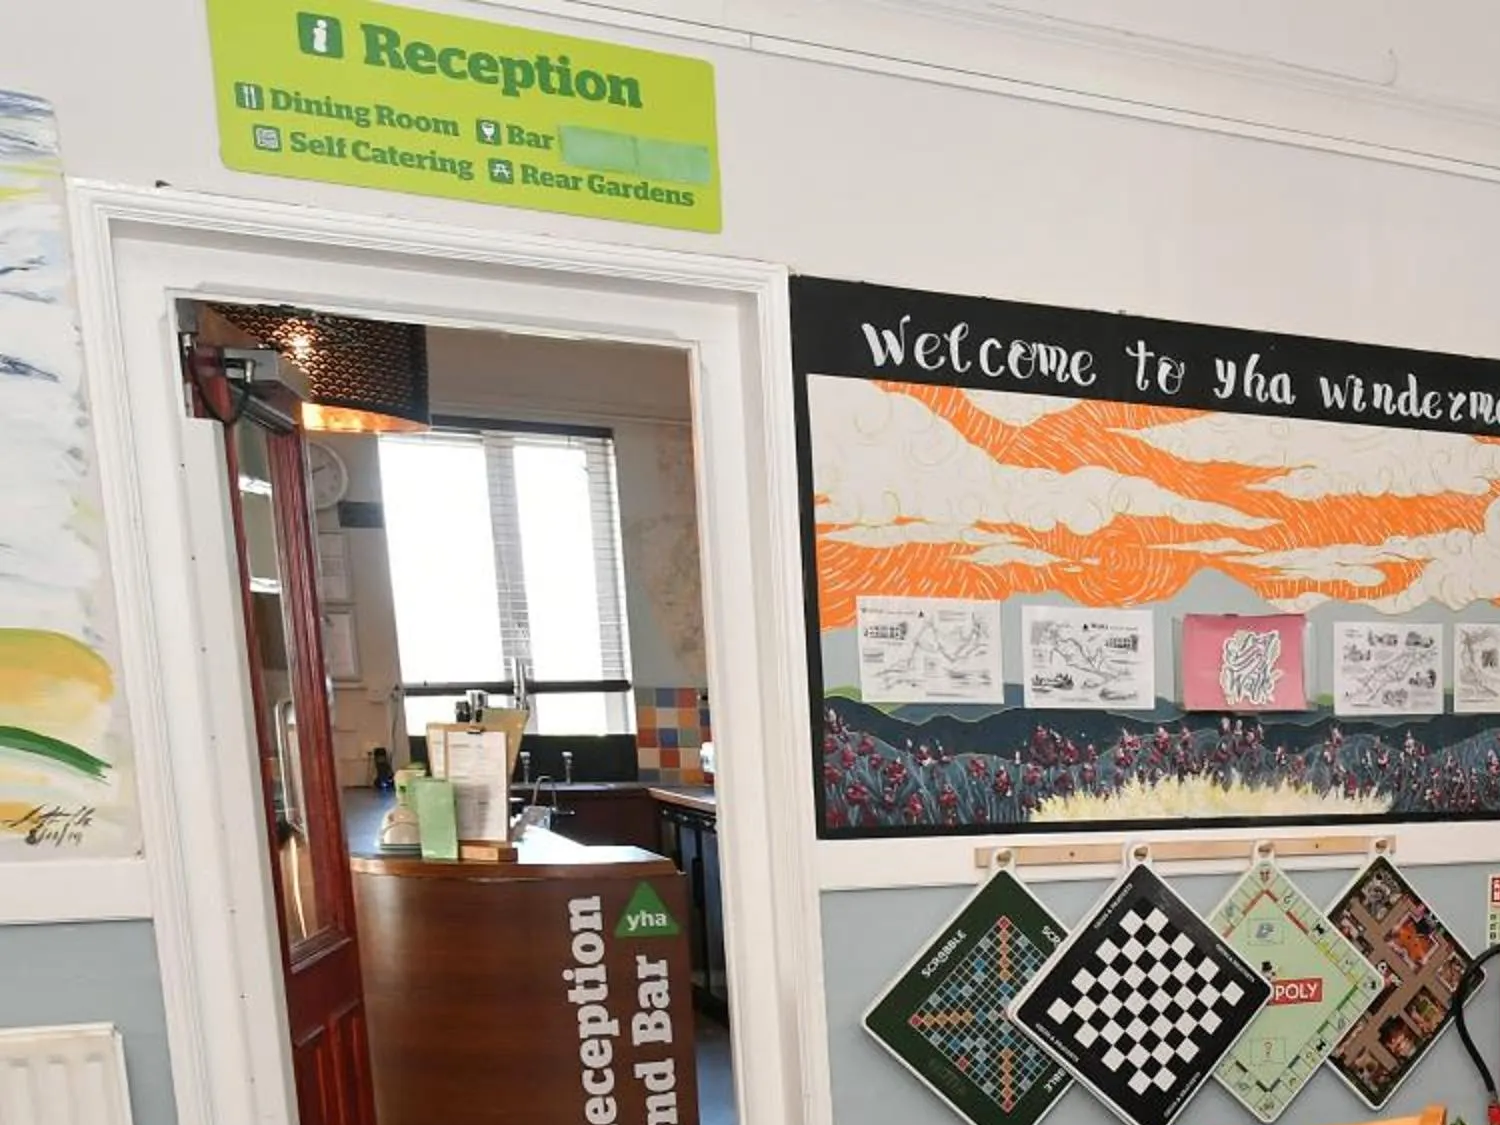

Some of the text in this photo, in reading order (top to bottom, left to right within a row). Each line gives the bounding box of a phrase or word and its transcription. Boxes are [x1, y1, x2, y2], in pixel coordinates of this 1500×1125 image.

[361, 22, 643, 109] Reception
[269, 87, 460, 137] Dining Room
[290, 131, 475, 181] Self Catering
[507, 124, 555, 151] Bar
[520, 165, 695, 207] Rear Gardens
[860, 316, 1097, 386] Welcome
[1124, 340, 1186, 395] to
[1214, 353, 1297, 406] yha
[626, 910, 667, 930] yha
[921, 929, 967, 977] SCRABBLE
[631, 954, 673, 1047] Bar
[1274, 982, 1319, 1001] POLY
